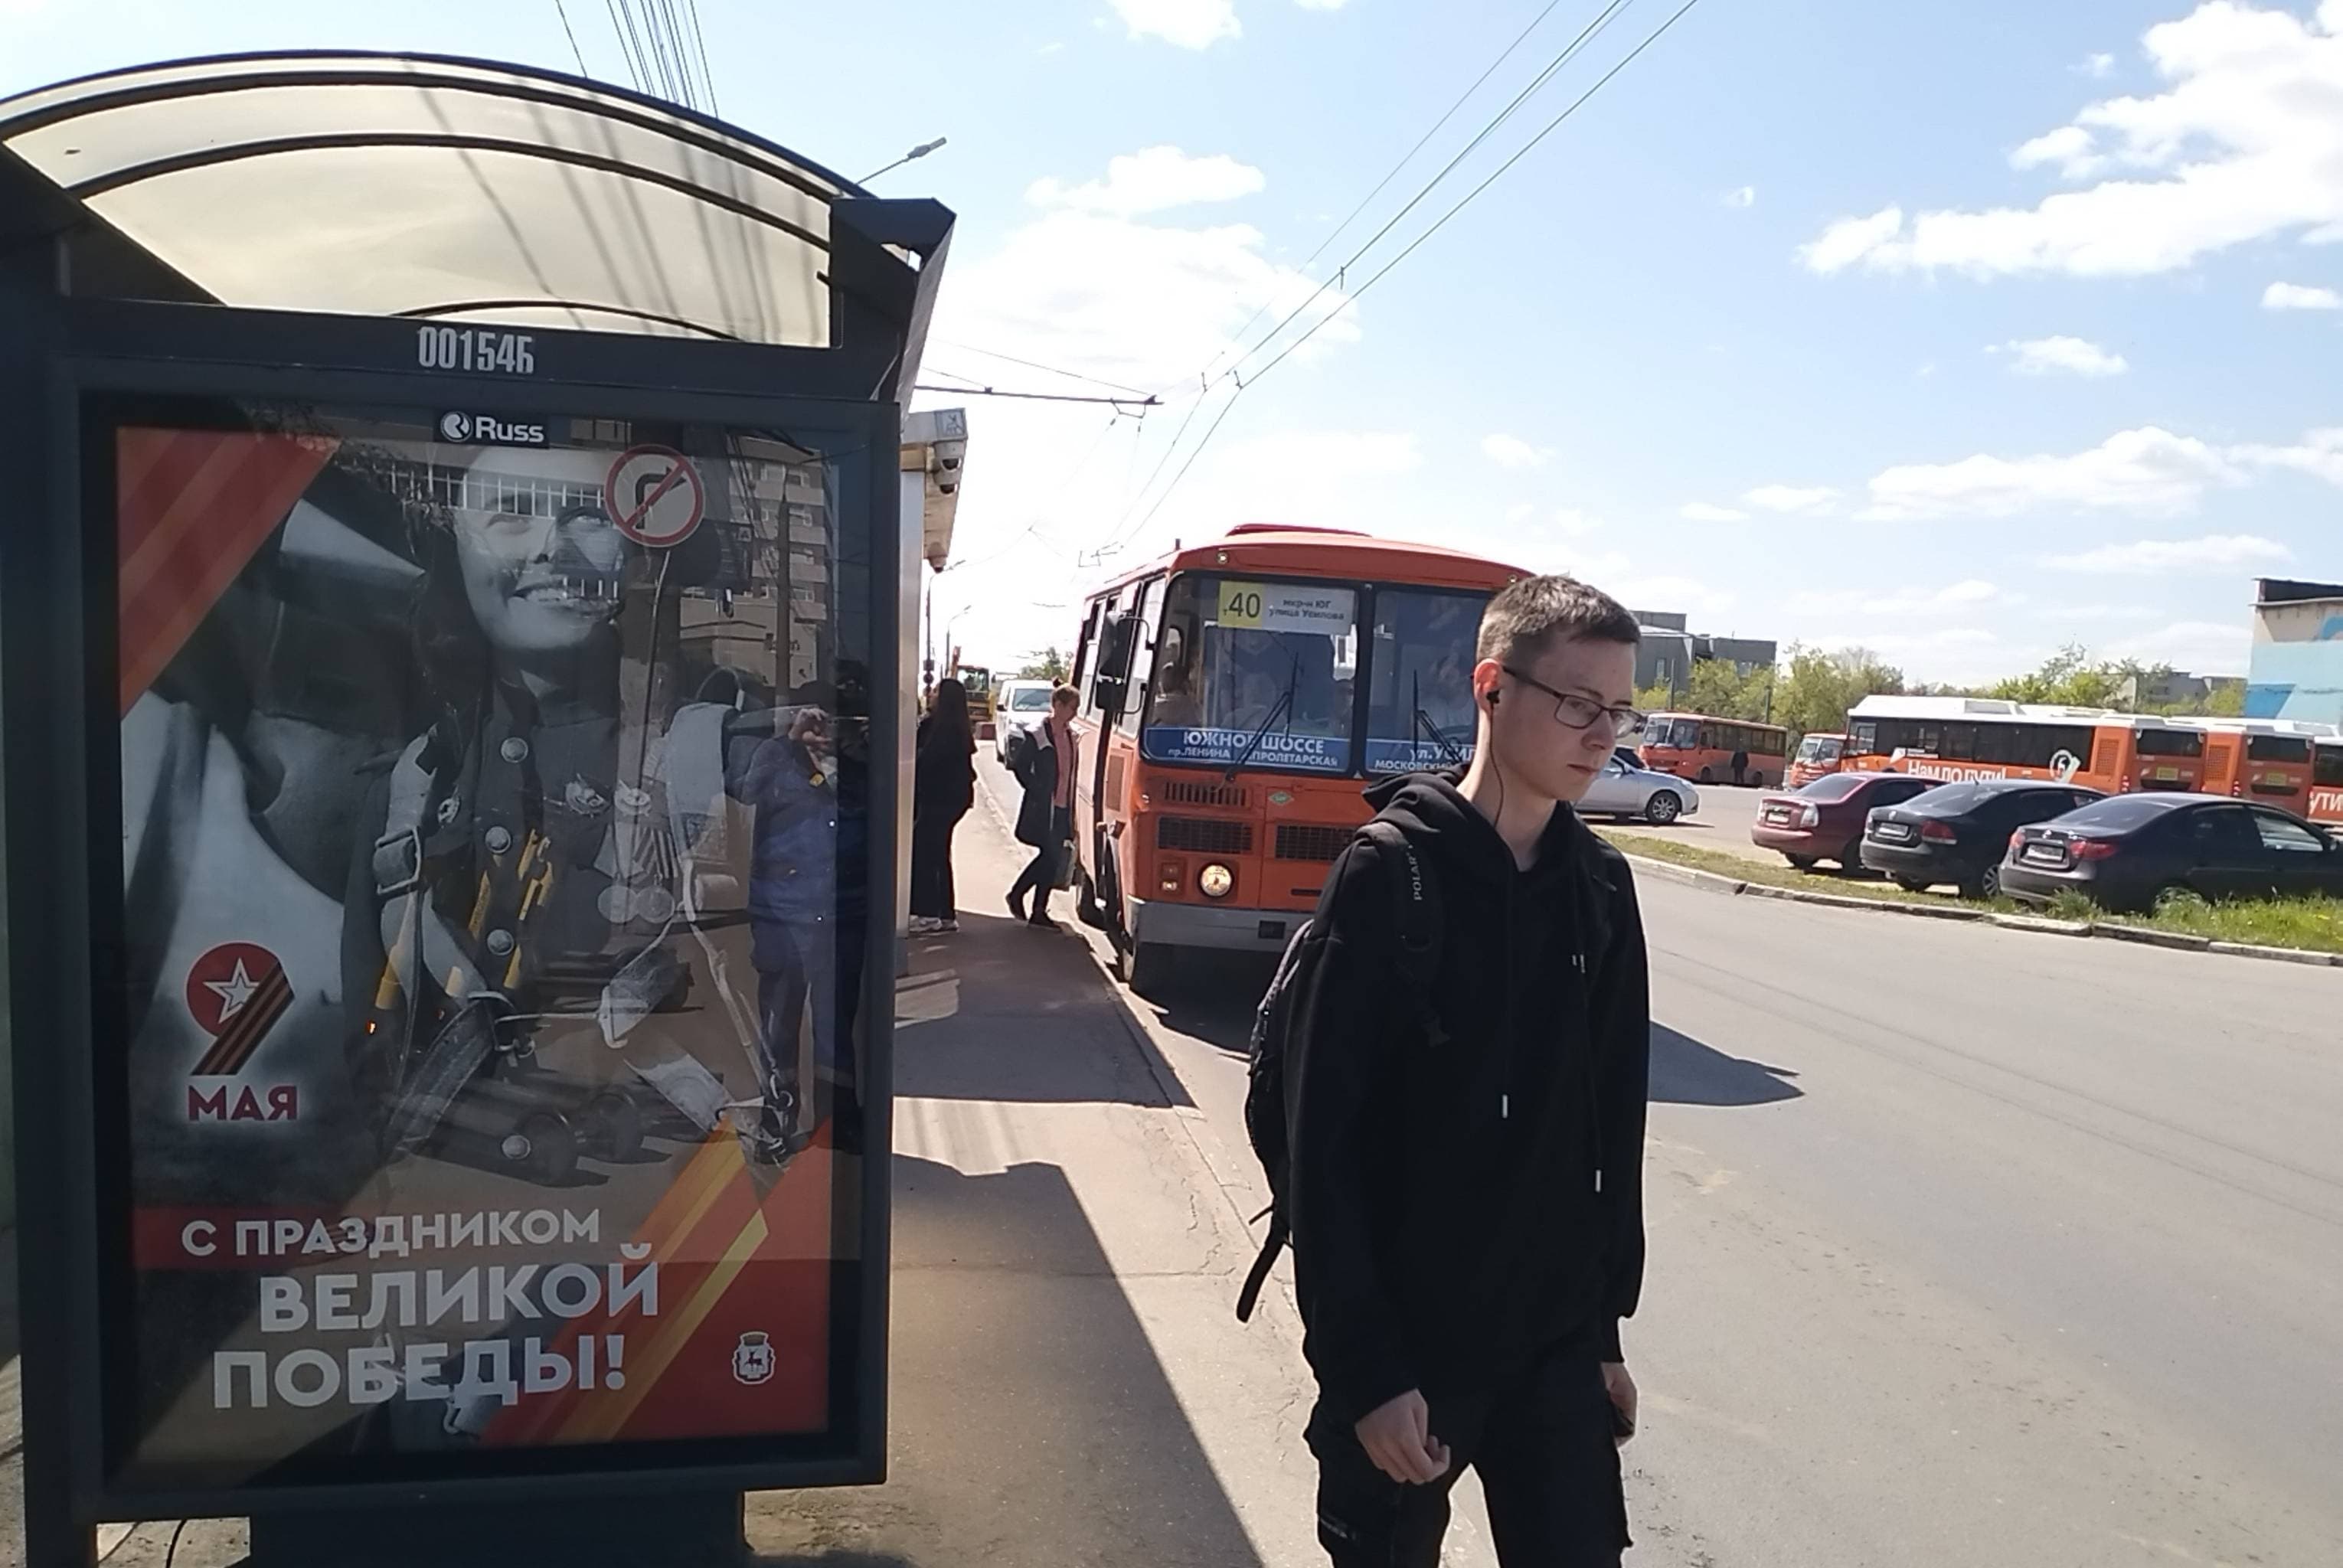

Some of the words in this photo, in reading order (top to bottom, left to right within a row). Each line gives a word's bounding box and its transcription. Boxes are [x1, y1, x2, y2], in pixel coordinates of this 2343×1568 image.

[475, 416, 544, 443] Russ
[1261, 736, 1324, 754] ШОССЕ
[1908, 760, 1940, 779] Нам
[188, 1085, 298, 1121] МАЯ
[181, 1220, 217, 1256] С
[235, 1209, 600, 1258] ПРАЗДНИКОМ
[260, 1243, 658, 1332] ВЕЛИКОЙ
[214, 1334, 626, 1408] ПОБЕДЫ!
